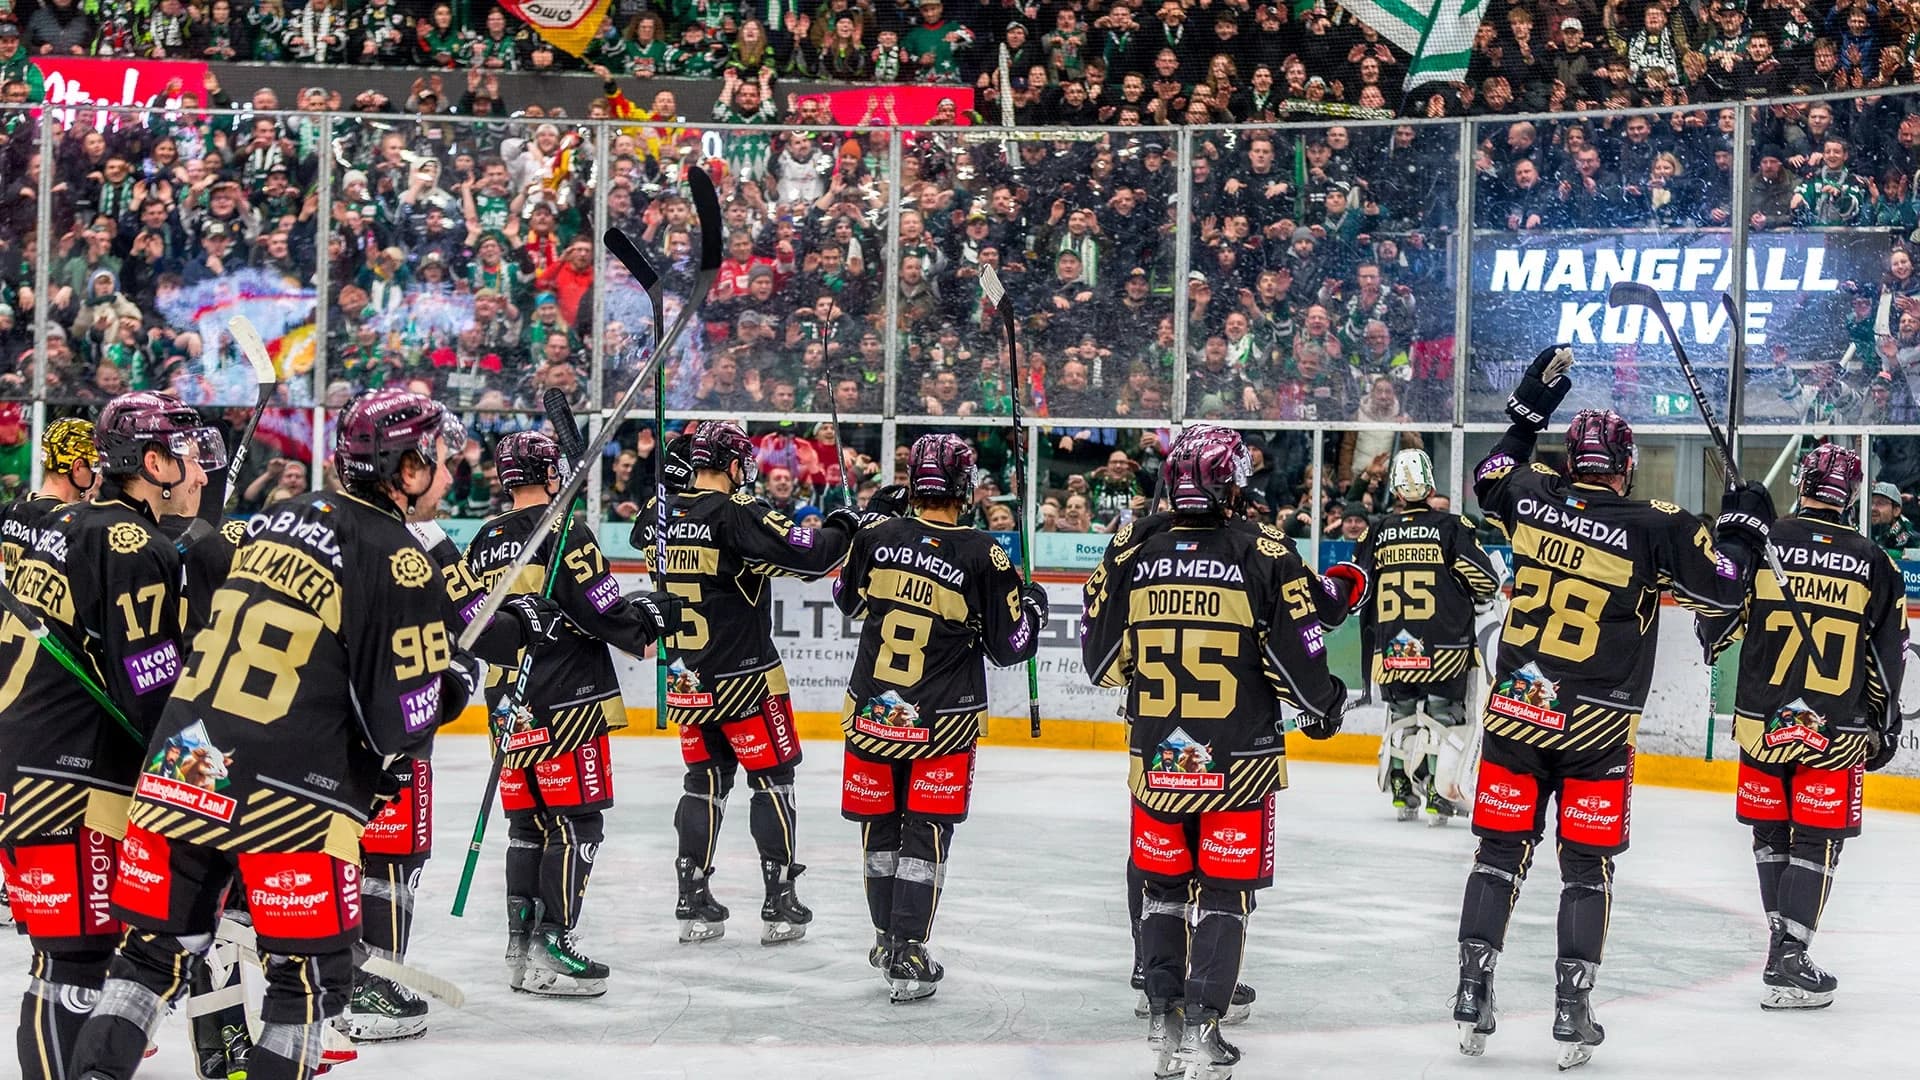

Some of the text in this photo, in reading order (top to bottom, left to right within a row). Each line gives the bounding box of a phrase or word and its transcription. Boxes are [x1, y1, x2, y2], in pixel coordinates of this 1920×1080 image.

[1490, 246, 1839, 292] MANGFALL
[1556, 300, 1773, 345] KURVE
[667, 522, 712, 542] MEDIA
[1399, 526, 1441, 541] MEDIA
[1517, 498, 1629, 550] OVB MEDIA
[646, 549, 699, 570] SHVYRIN
[1076, 543, 1105, 554] Rose
[1537, 535, 1585, 570] KOLB
[564, 543, 605, 584] 57
[874, 546, 966, 589] OVB MEDIA
[1176, 558, 1244, 584] MEDIA
[1811, 549, 1871, 580] MEDIA
[895, 575, 934, 606] LAUB
[1149, 590, 1220, 617] DODERO
[1377, 571, 1436, 623] 65
[1787, 577, 1849, 605] TRAMM
[116, 583, 166, 642] 17
[1502, 566, 1611, 664] 28
[170, 589, 324, 725] 98
[392, 621, 449, 681] 98
[873, 608, 933, 688] 8
[1765, 610, 1859, 697] 70
[1137, 628, 1240, 719] 55
[1540, 711, 1560, 726] Land
[907, 729, 925, 740] Land
[1806, 733, 1824, 748] Land
[844, 779, 891, 799] Flötzinger
[913, 778, 965, 794] Flötzinger
[1200, 775, 1219, 788] Land
[198, 795, 228, 816] Land
[415, 759, 429, 847] vitagrou
[1479, 790, 1532, 812] Flötzinger
[1796, 792, 1844, 808] Flötzinger
[1564, 805, 1621, 823] Flötzinger
[365, 821, 408, 835] ötzinger
[1202, 838, 1257, 857] Flötzinger
[90, 831, 111, 927] vitagro
[252, 888, 329, 910] Flötzinger
